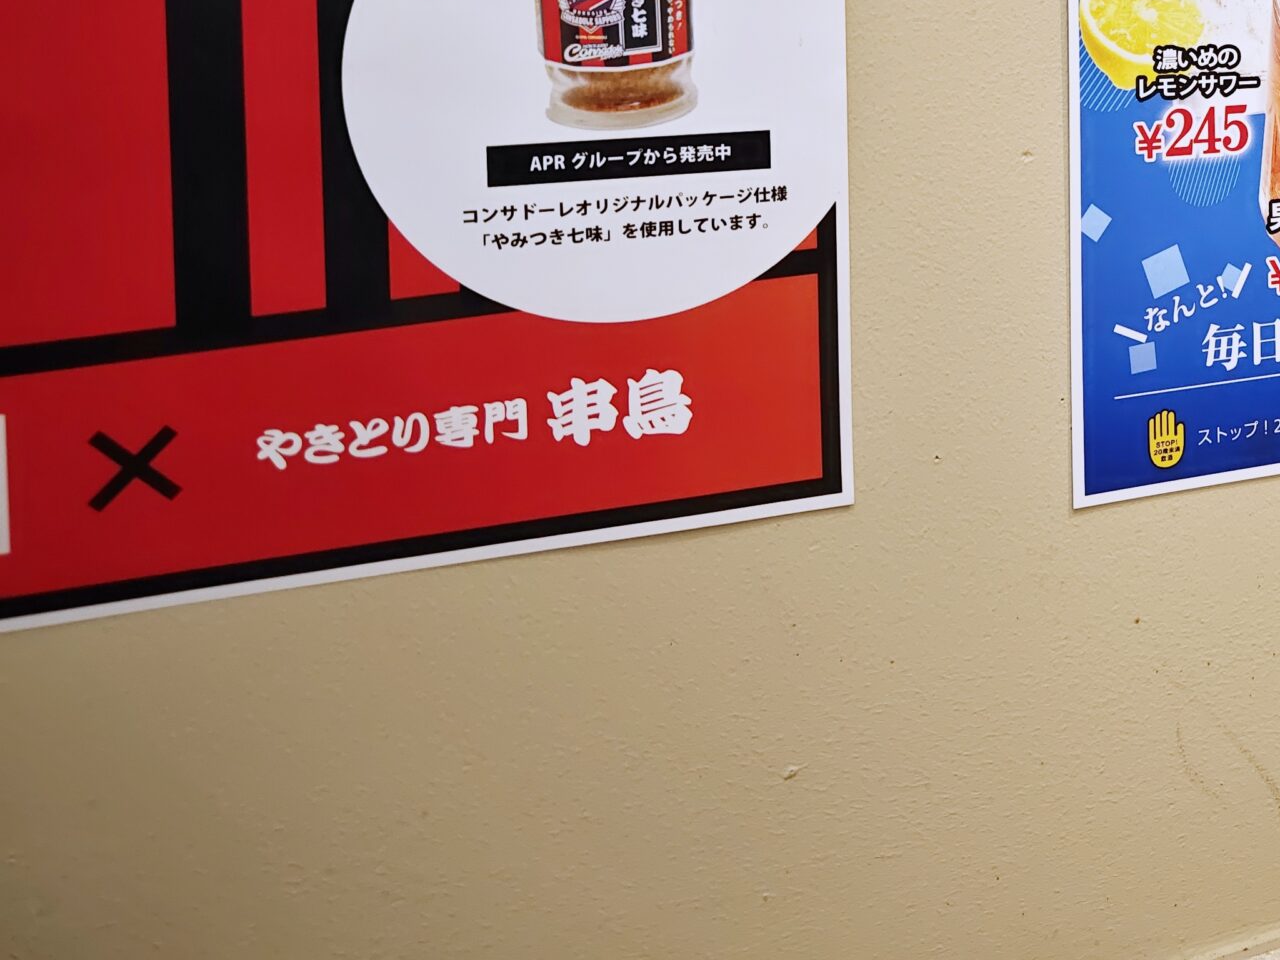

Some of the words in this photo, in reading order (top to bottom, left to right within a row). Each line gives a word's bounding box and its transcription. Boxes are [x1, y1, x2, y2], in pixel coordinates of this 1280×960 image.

[1152, 45, 1240, 72] 濃いめの
[1136, 73, 1260, 101] レモンサワー
[1137, 104, 1249, 160] ¥245
[530, 154, 566, 172] APR
[571, 144, 732, 170] グループから発売中
[462, 185, 788, 224] コンサドーレオリジナルパッケージ仕様
[481, 212, 771, 251] 「やみつき七味」を使用しています。
[256, 398, 528, 470] やきとり専門
[547, 368, 693, 446] 串鳥
